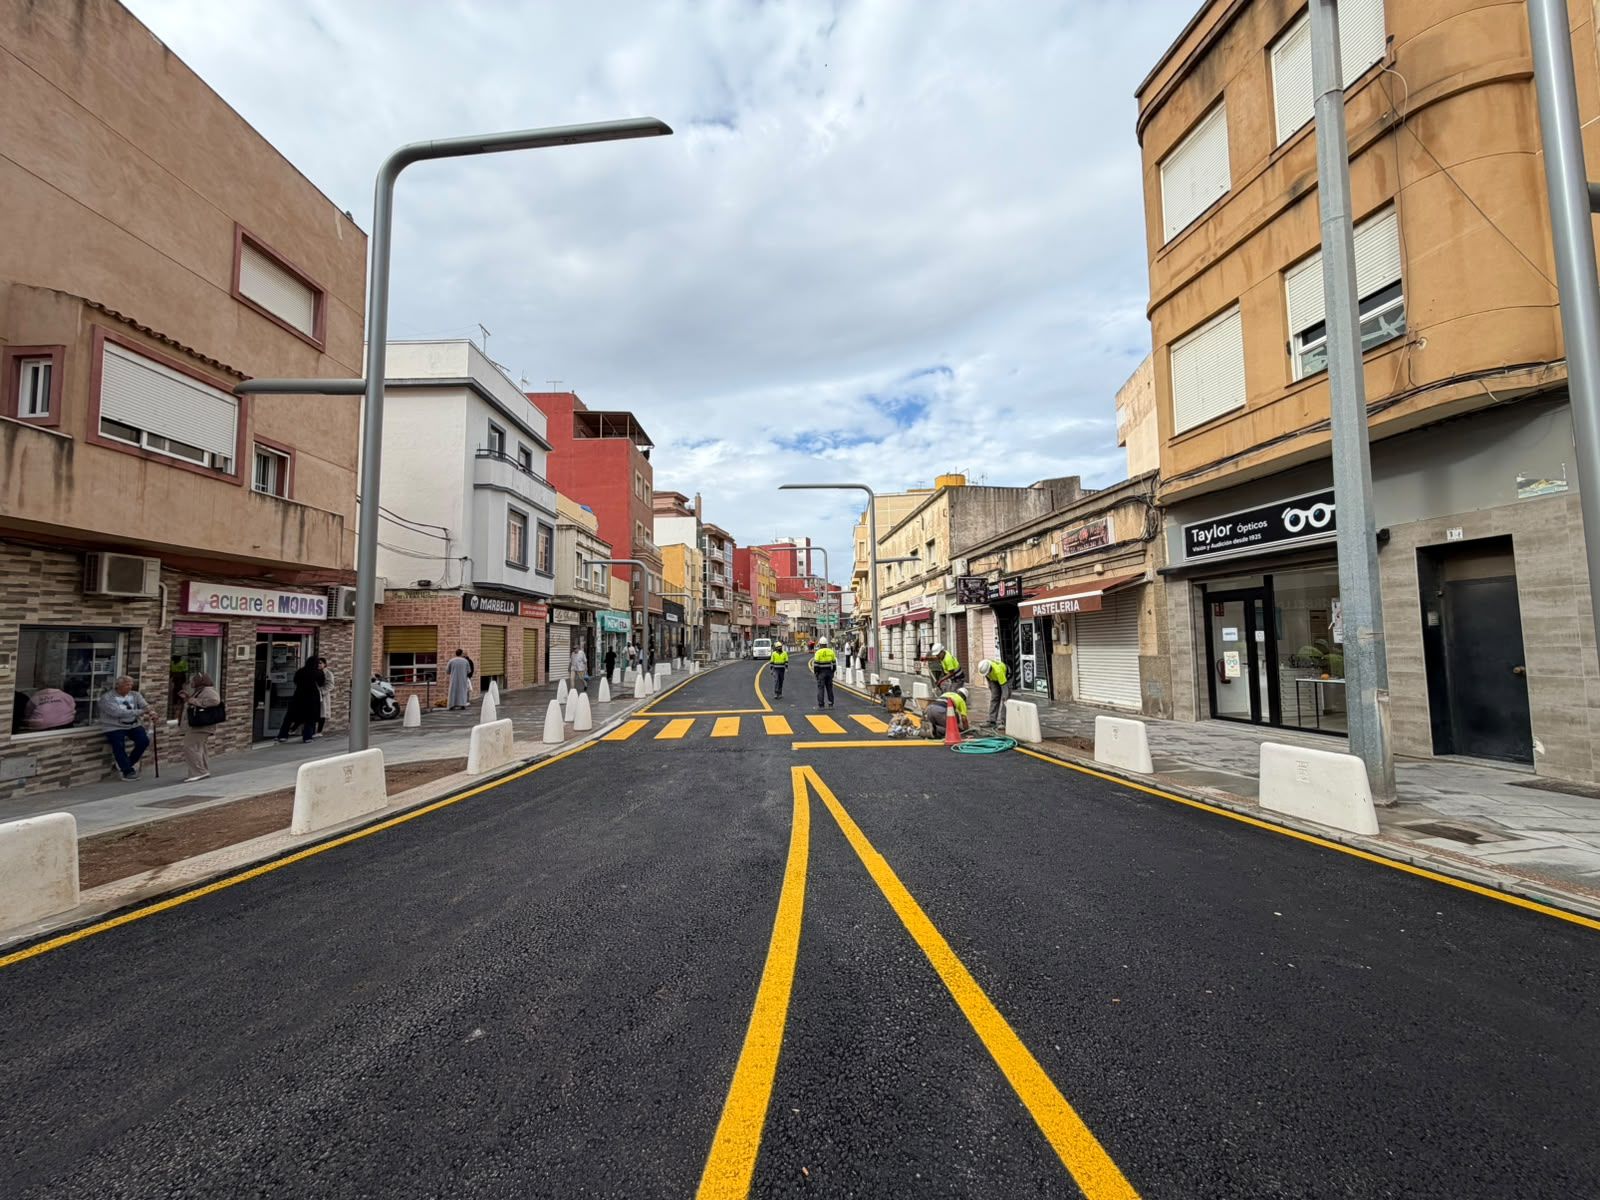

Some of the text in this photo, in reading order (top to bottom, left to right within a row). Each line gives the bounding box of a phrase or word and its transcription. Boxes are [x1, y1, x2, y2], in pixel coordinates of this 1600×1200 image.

[1191, 520, 1268, 543] Taylor Ópticos
[1232, 536, 1248, 545] desde
[209, 593, 324, 616] acuarela MODAS
[480, 598, 515, 613] MARBELLA
[1032, 600, 1080, 616] PASTELERIA
